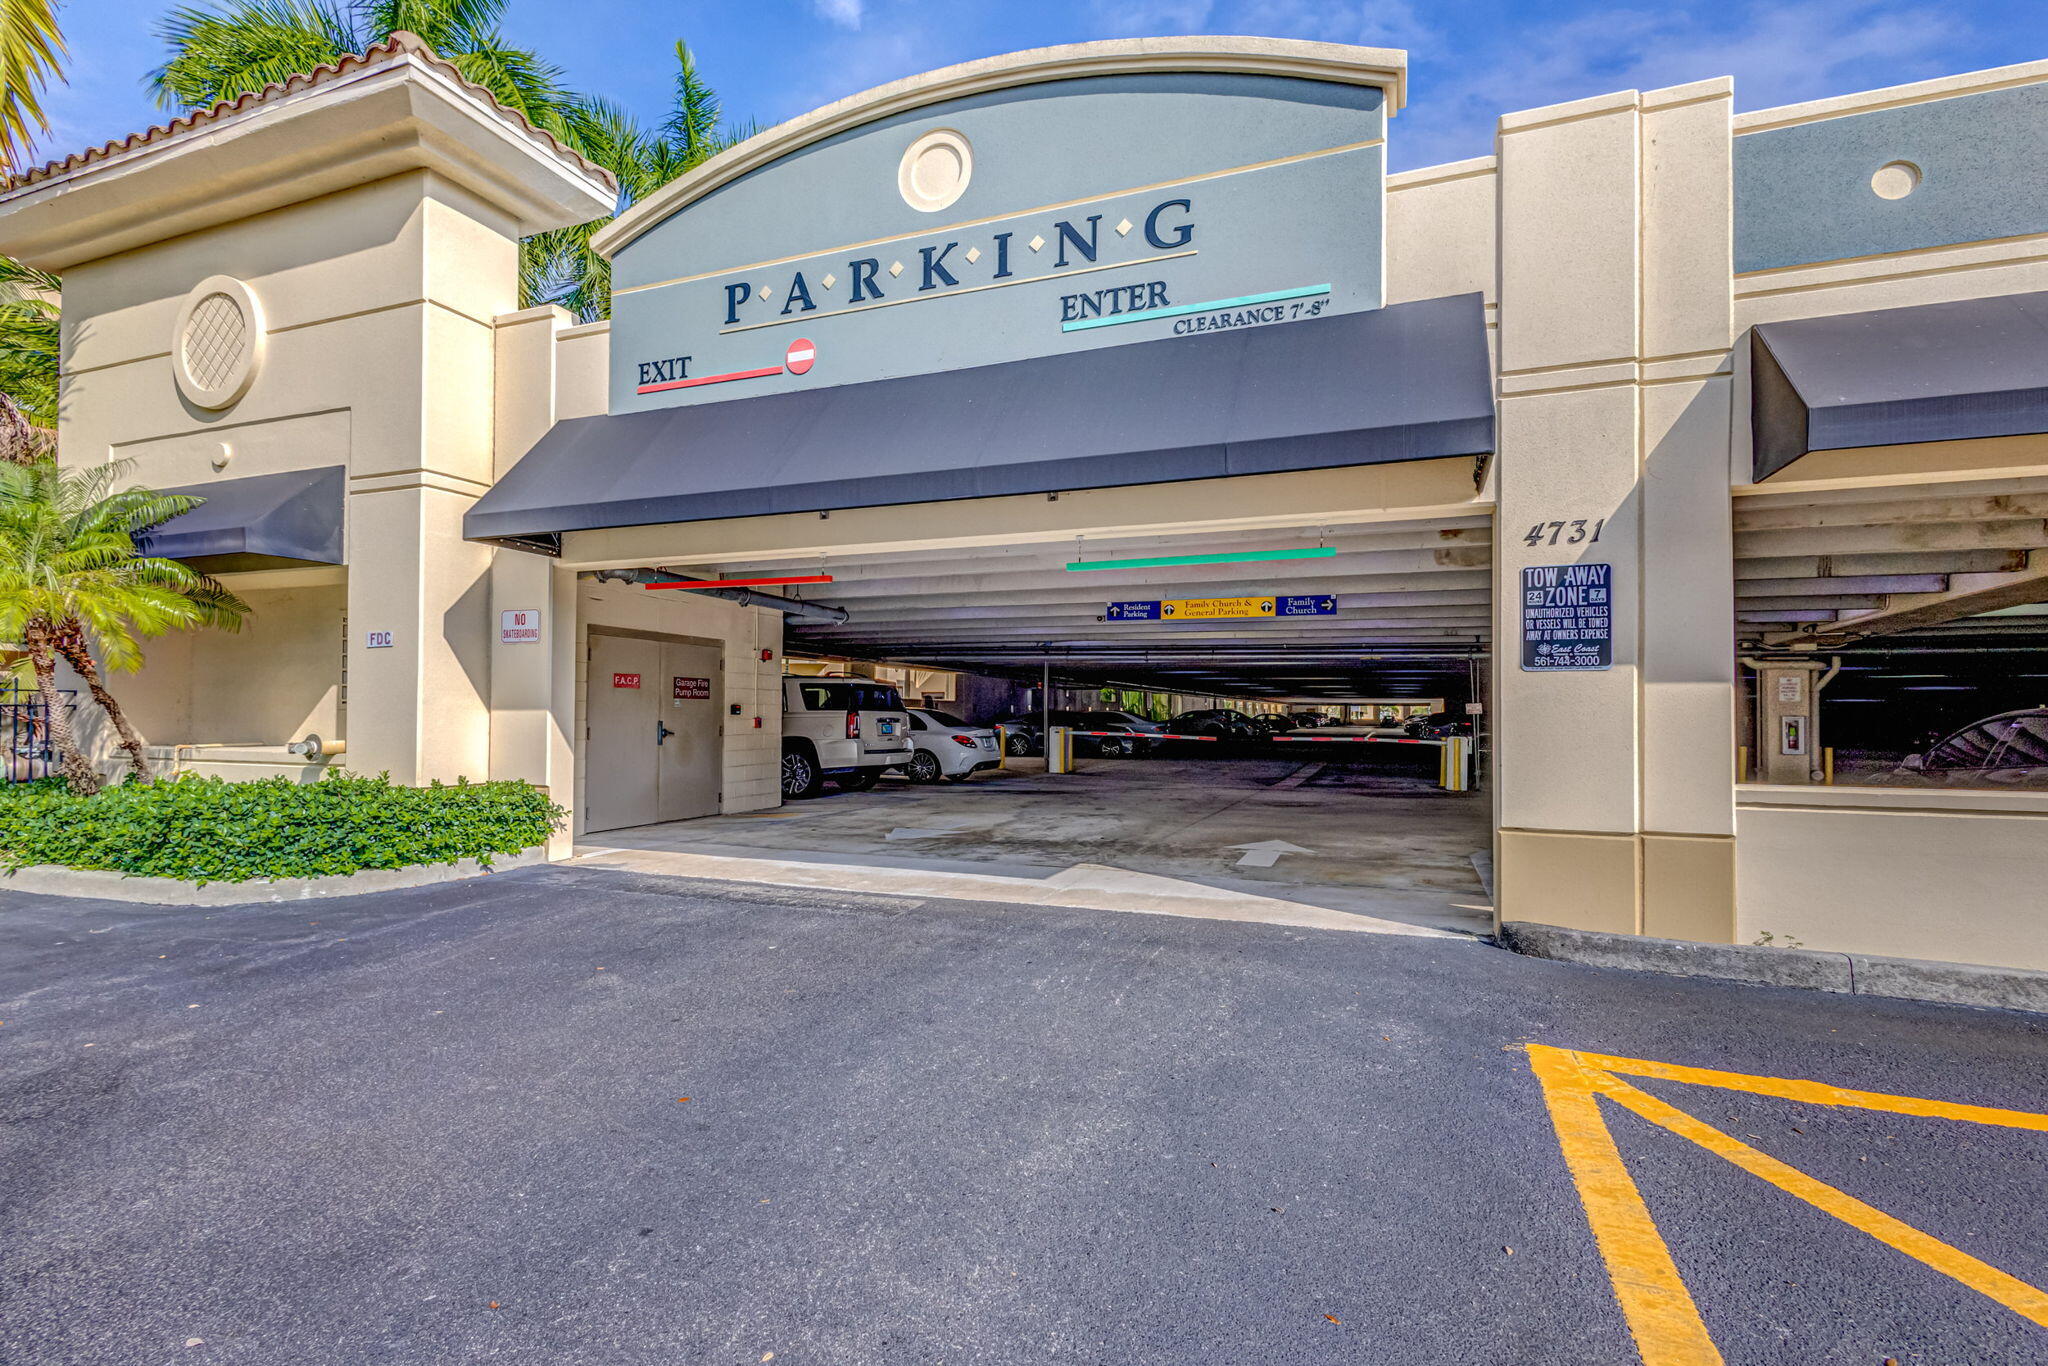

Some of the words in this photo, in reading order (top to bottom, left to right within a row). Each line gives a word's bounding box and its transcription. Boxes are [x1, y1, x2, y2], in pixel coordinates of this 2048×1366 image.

[1060, 281, 1171, 322] ENTER
[1173, 306, 1285, 335] CLEARANCE
[638, 356, 692, 386] EXIT
[1524, 519, 1606, 547] 4731
[1525, 568, 1558, 588] TOW
[1565, 565, 1607, 586] AWAY
[1528, 592, 1542, 601] 24
[1545, 586, 1588, 607] ZONE
[1594, 590, 1601, 598] 7
[1185, 601, 1209, 609] Family
[1286, 597, 1316, 608] Family
[1184, 608, 1216, 617] General
[1218, 606, 1249, 616] Parking
[1285, 606, 1317, 615] Church
[1525, 607, 1575, 619] UNAUTHORIZED
[1576, 606, 1608, 617] VEHICLES
[514, 613, 526, 625] NO
[1525, 619, 1534, 630] OR
[1535, 619, 1561, 630] VESSELS
[1563, 618, 1577, 629] WILL
[1578, 618, 1587, 629] BE
[1588, 617, 1609, 628] TOWED
[370, 632, 391, 646] FDC
[503, 628, 538, 639] SKATEBOARDING
[1525, 630, 1542, 641] AWAY
[1543, 630, 1552, 640] AT
[1553, 629, 1579, 640] OWNERS
[1580, 628, 1609, 640] EXPENSE
[1551, 644, 1572, 654] East
[1574, 643, 1600, 653] Coast
[675, 679, 697, 688] Garage
[698, 679, 709, 688] Fire
[675, 688, 692, 697] Pump
[693, 688, 709, 697] Room
